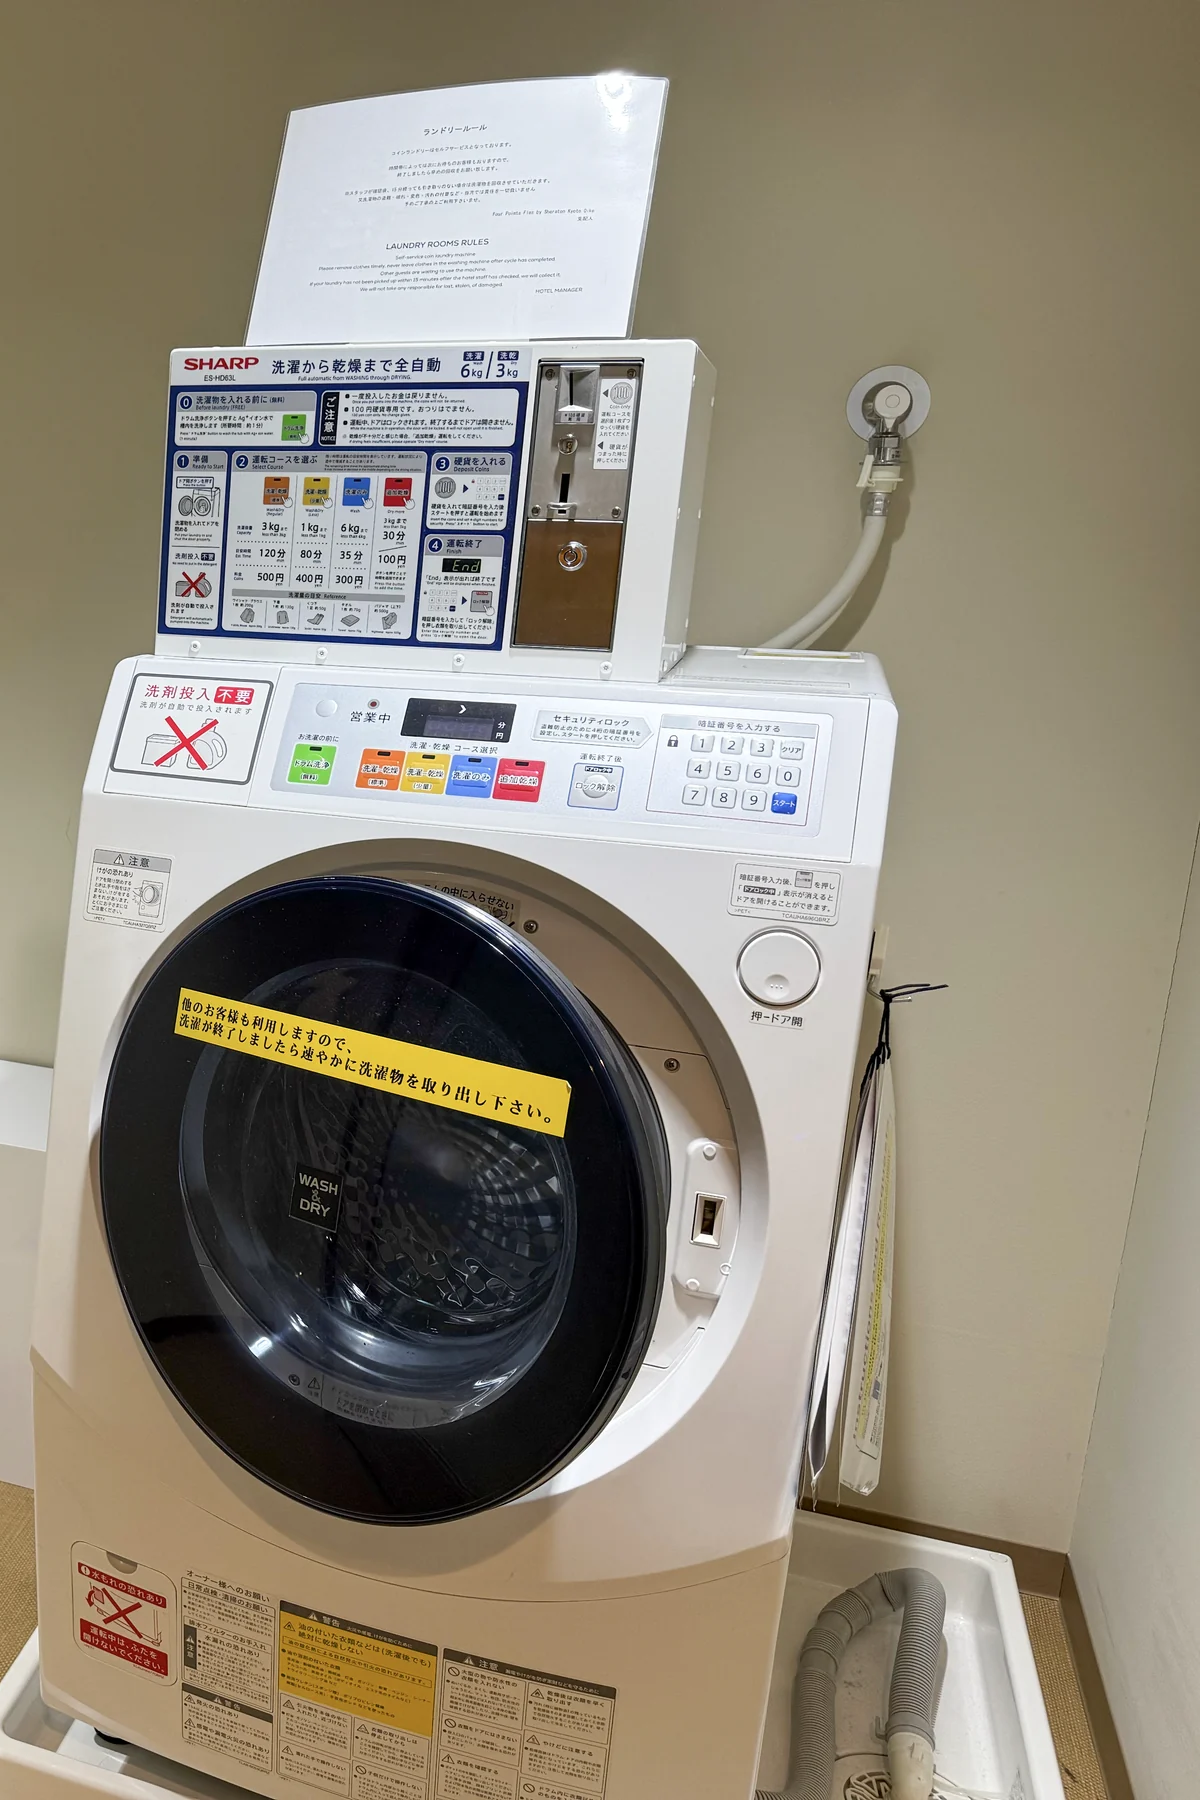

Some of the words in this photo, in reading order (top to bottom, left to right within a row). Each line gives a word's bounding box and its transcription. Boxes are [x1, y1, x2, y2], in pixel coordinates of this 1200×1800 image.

[423, 124, 487, 136] ランドリールール
[461, 238, 489, 246] RULES
[184, 357, 259, 370] SHARP
[272, 357, 441, 374] 洗濯から乾燥まで全自動
[196, 396, 267, 404] 洗濯物を入れる前に
[324, 396, 336, 433] ご注意
[193, 455, 208, 463] 準備
[252, 455, 317, 464] 運転コースを選ぶ
[454, 457, 506, 465] 硬貨を入れる
[383, 531, 405, 540] 30分
[447, 539, 482, 548] 運転終了
[260, 549, 286, 558] 120分
[300, 550, 322, 559] 80分
[340, 551, 363, 560] 35分
[379, 555, 406, 564] 100円
[452, 560, 480, 571] End
[258, 573, 284, 582] 500円
[296, 574, 323, 583] 400円
[336, 576, 363, 585] 300円
[145, 685, 210, 700] 洗剤投入
[218, 689, 252, 703] 不要
[140, 701, 252, 714] 洗剤が自動で投入されます
[351, 711, 391, 724] 営業中
[554, 715, 629, 726] セキュリティロック
[541, 724, 641, 736] 盗難防止のために4桁の暗証番号を
[698, 721, 780, 732] 暗証番号を入力する
[298, 734, 339, 742] お洗濯の前に
[540, 730, 635, 742] 設定し、スタートを押してください。
[410, 742, 450, 750] 洗濯・乾燥
[455, 746, 498, 754] コース選択
[700, 739, 704, 748] 1
[728, 741, 735, 750] 2
[757, 743, 764, 752] 3
[580, 753, 621, 762] 運転終了後
[694, 764, 702, 773] 4
[724, 766, 731, 775] 5
[754, 769, 761, 778] 6
[500, 776, 537, 785] 追加乾燥
[784, 771, 792, 781] 0
[576, 783, 615, 791] ロック解除
[691, 790, 699, 799] 7
[720, 793, 728, 802] 8
[750, 796, 758, 805] 9
[129, 856, 150, 867] 注意
[97, 868, 133, 877] けがの恐れあり
[740, 874, 792, 886] 暗証番号入力後、
[737, 896, 830, 912] ドアを開けることができます。
[182, 997, 353, 1054] 他のお客様も利用しますので、
[178, 1014, 551, 1125] 洗濯が終了しましたら速やかに洗濯物を取り出し下さい。
[299, 1173, 338, 1195] WASH
[299, 1198, 330, 1217] DRY
[92, 1571, 163, 1604] 水もれの恐れあり
[187, 1570, 270, 1602] オーナー様へのお願い
[189, 1582, 268, 1612] 日常点検・清掃のお願い
[323, 1616, 340, 1627] 警告
[189, 1620, 266, 1650] 排水フィルターのお手入れ
[90, 1626, 157, 1659] 運転中は、ふたを
[205, 1635, 259, 1657] 水漏れの恐れあり
[299, 1632, 363, 1656] 絶対に乾燥しない
[83, 1633, 164, 1672] 開けないでください。
[479, 1660, 498, 1671] 注意
[546, 1696, 572, 1706] 取り出す
[196, 1700, 239, 1718] 発火の恐れあり
[458, 1723, 518, 1742] 衣類をドアにはさまない
[543, 1741, 594, 1756] やけどに注意する
[456, 1759, 498, 1775] 衣類を確認する
